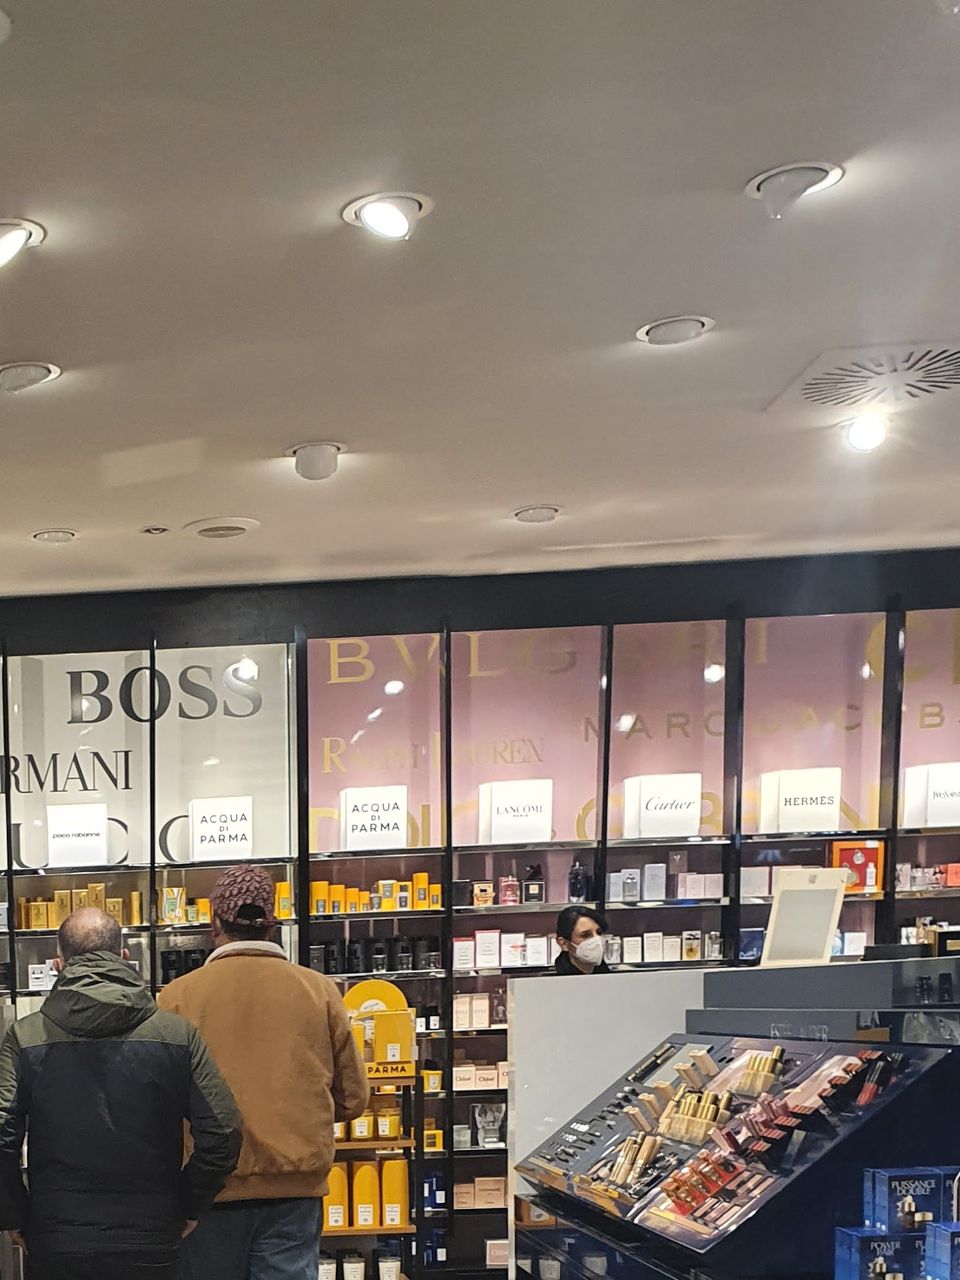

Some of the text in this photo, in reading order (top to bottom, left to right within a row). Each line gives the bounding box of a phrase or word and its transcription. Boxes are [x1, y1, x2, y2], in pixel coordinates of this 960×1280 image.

[67, 664, 264, 724] BOSS
[351, 802, 401, 813] ACQUA
[645, 795, 695, 813] Cartier
[199, 813, 248, 824] ACQUA
[351, 822, 401, 833] PARMA
[199, 833, 249, 844] PARMA
[367, 1065, 407, 1074] PARMA
